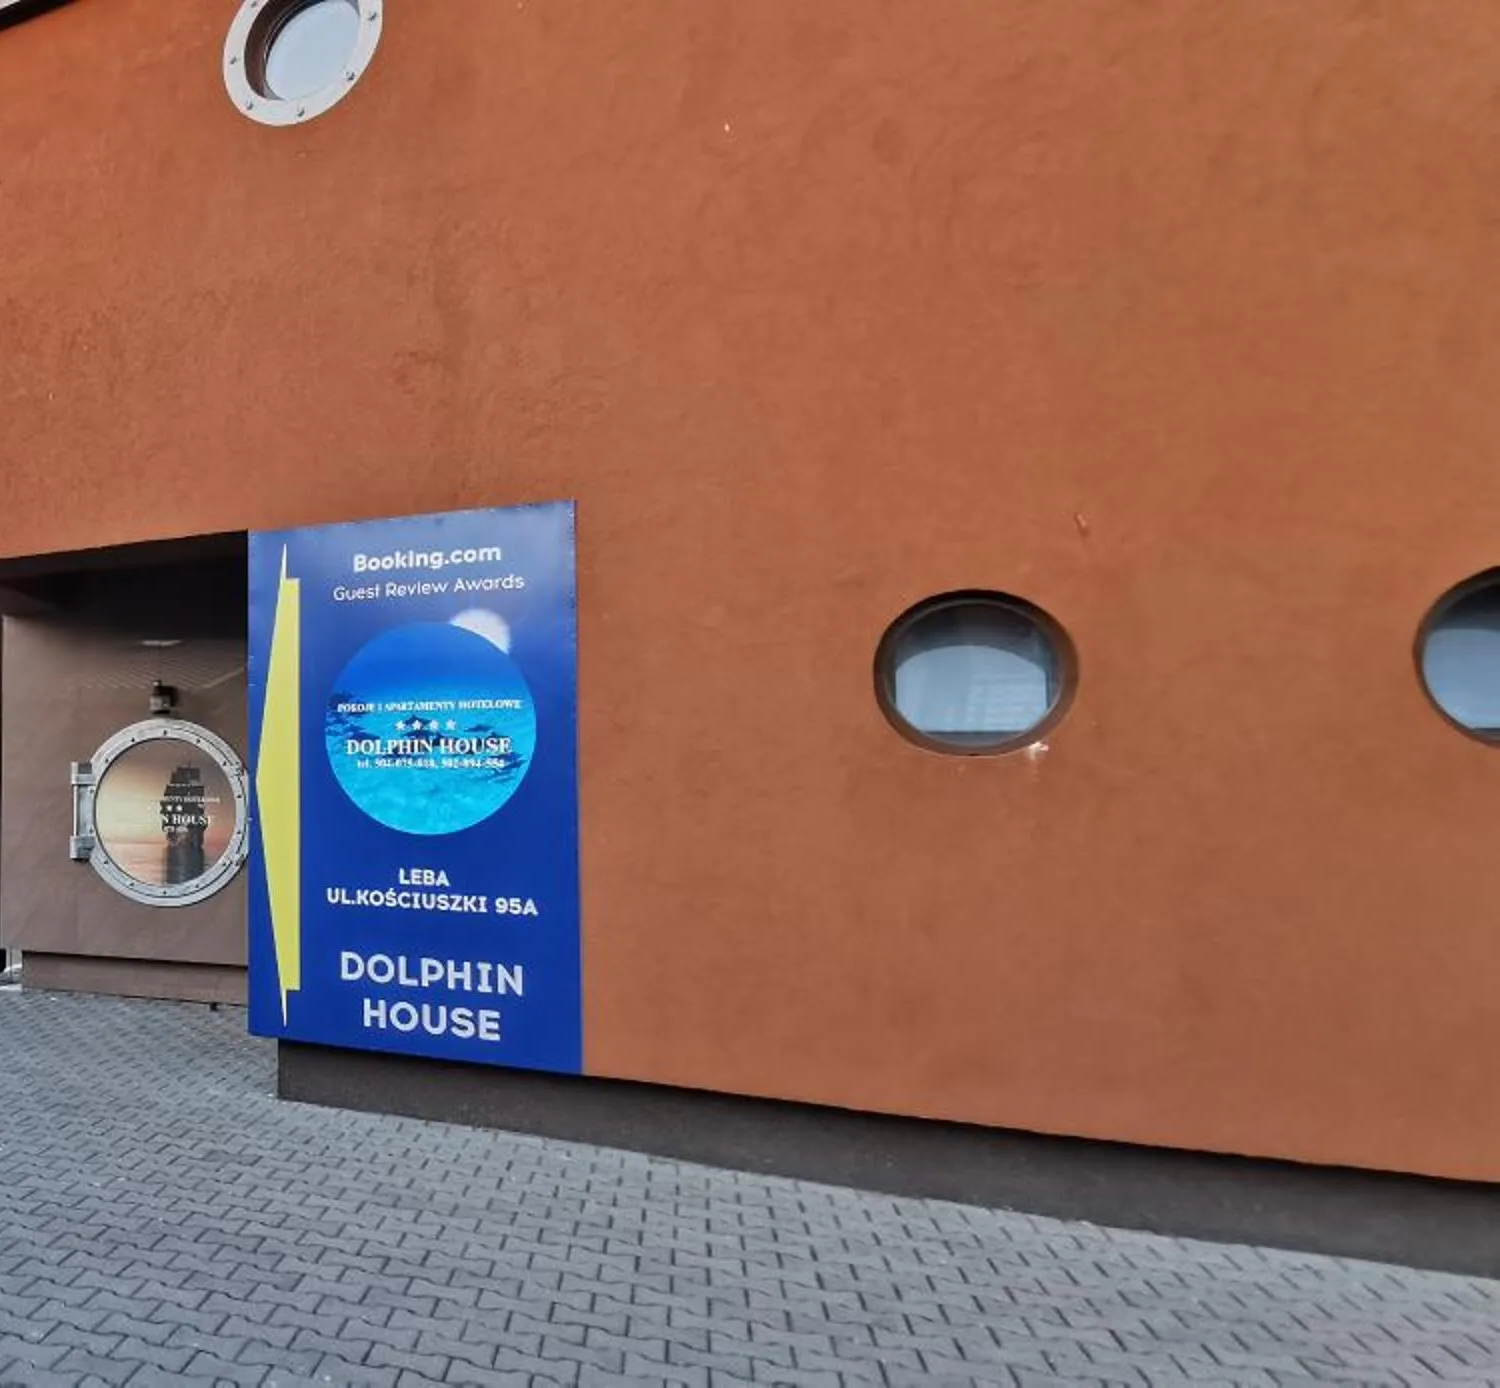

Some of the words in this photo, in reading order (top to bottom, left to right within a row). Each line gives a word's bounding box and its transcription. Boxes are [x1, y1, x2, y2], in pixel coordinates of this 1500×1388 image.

[353, 546, 502, 573] Booking.com
[333, 582, 380, 602] Guest
[385, 579, 448, 598] Review
[453, 573, 525, 592] Awards
[346, 738, 434, 756] DOLPHIN
[439, 736, 513, 755] HOUSE
[326, 887, 488, 914] UL.KOŚCIUSZKI
[494, 897, 539, 917] 95A
[339, 950, 524, 996] DOLPHIN
[362, 997, 502, 1041] HOUSE
